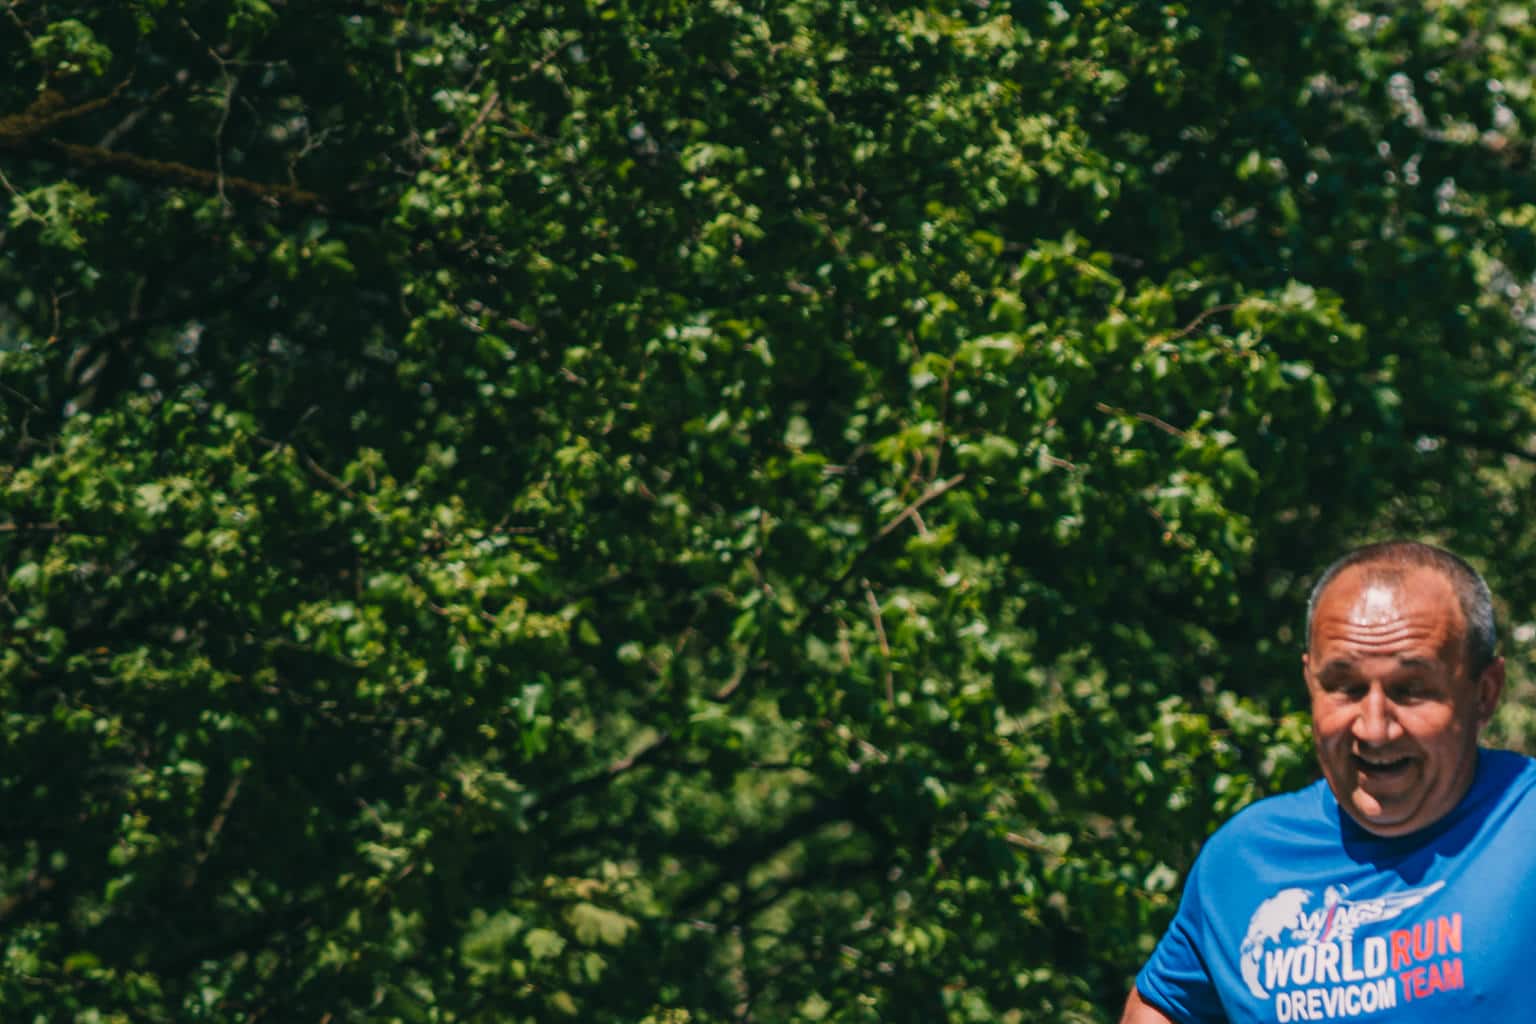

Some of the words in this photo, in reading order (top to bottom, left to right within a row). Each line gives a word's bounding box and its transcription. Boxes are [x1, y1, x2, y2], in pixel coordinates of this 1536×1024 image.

[1265, 936, 1388, 990] WORLD
[1390, 913, 1462, 970] RUN
[1401, 958, 1464, 1002] TEAM
